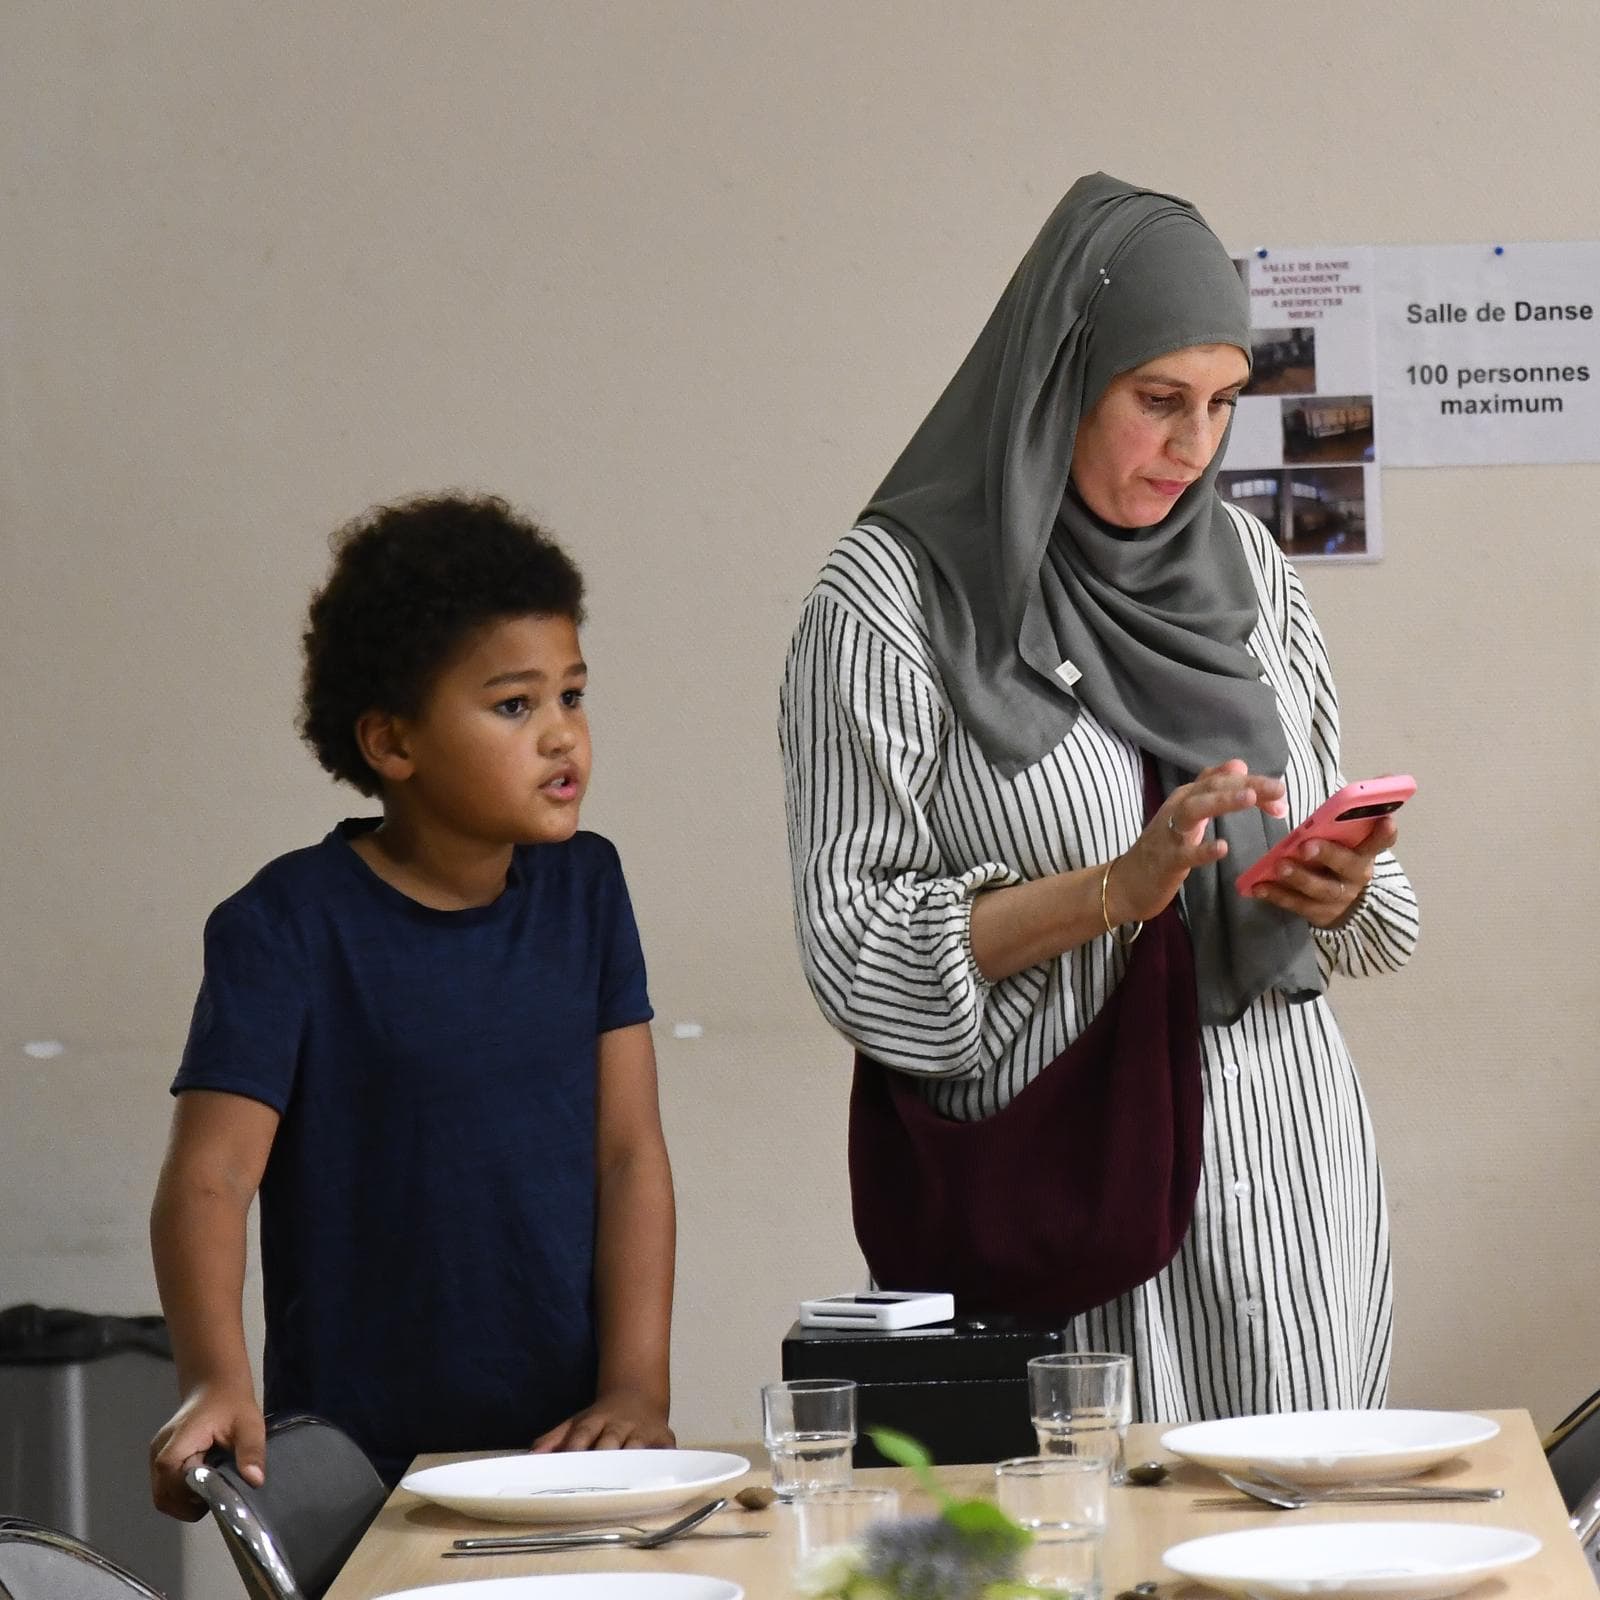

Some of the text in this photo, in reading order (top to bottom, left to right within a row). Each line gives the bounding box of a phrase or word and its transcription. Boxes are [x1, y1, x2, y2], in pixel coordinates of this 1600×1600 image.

[1298, 262, 1311, 271] DE
[1315, 261, 1349, 270] DANSE
[1272, 274, 1340, 284] RANGEMENT
[1336, 285, 1361, 294] TYPE
[1287, 310, 1323, 319] MERCI
[1407, 301, 1593, 324] Salle de Danse
[1406, 364, 1590, 389] 100 personnes
[1440, 394, 1563, 415] maximum
